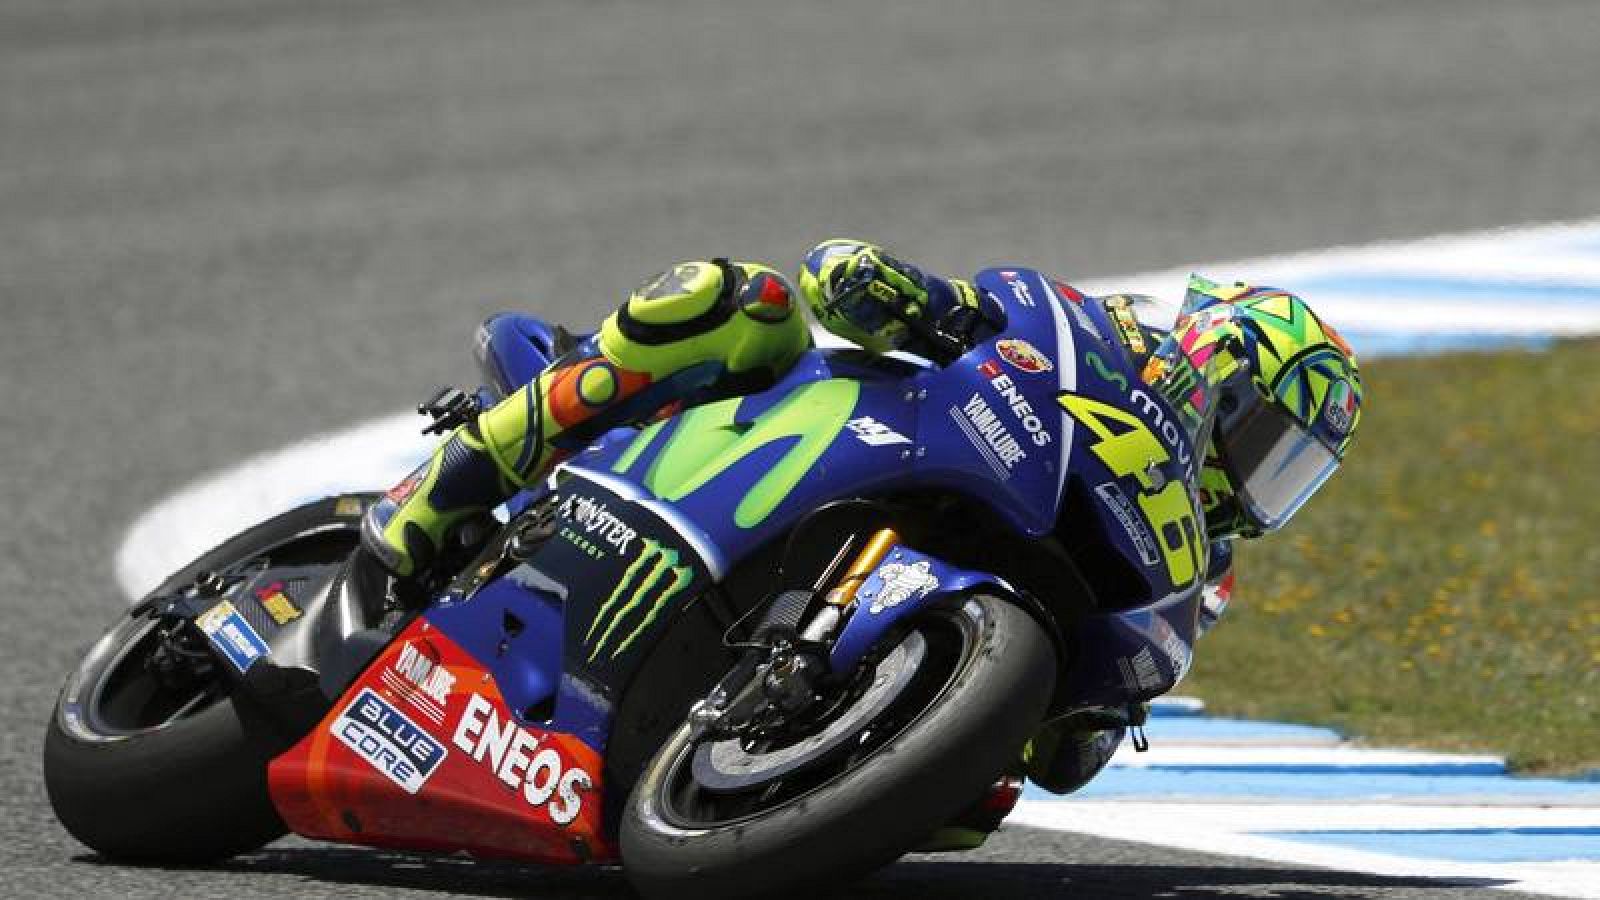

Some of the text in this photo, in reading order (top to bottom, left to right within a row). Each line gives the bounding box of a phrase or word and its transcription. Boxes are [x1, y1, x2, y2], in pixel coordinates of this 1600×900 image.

[963, 392, 1026, 469] YAMALUBE
[992, 374, 1051, 446] ENEOS
[1057, 393, 1204, 586] 46
[341, 722, 415, 782] CORE
[359, 698, 434, 761] BLUE
[453, 692, 593, 824] ENEOS
